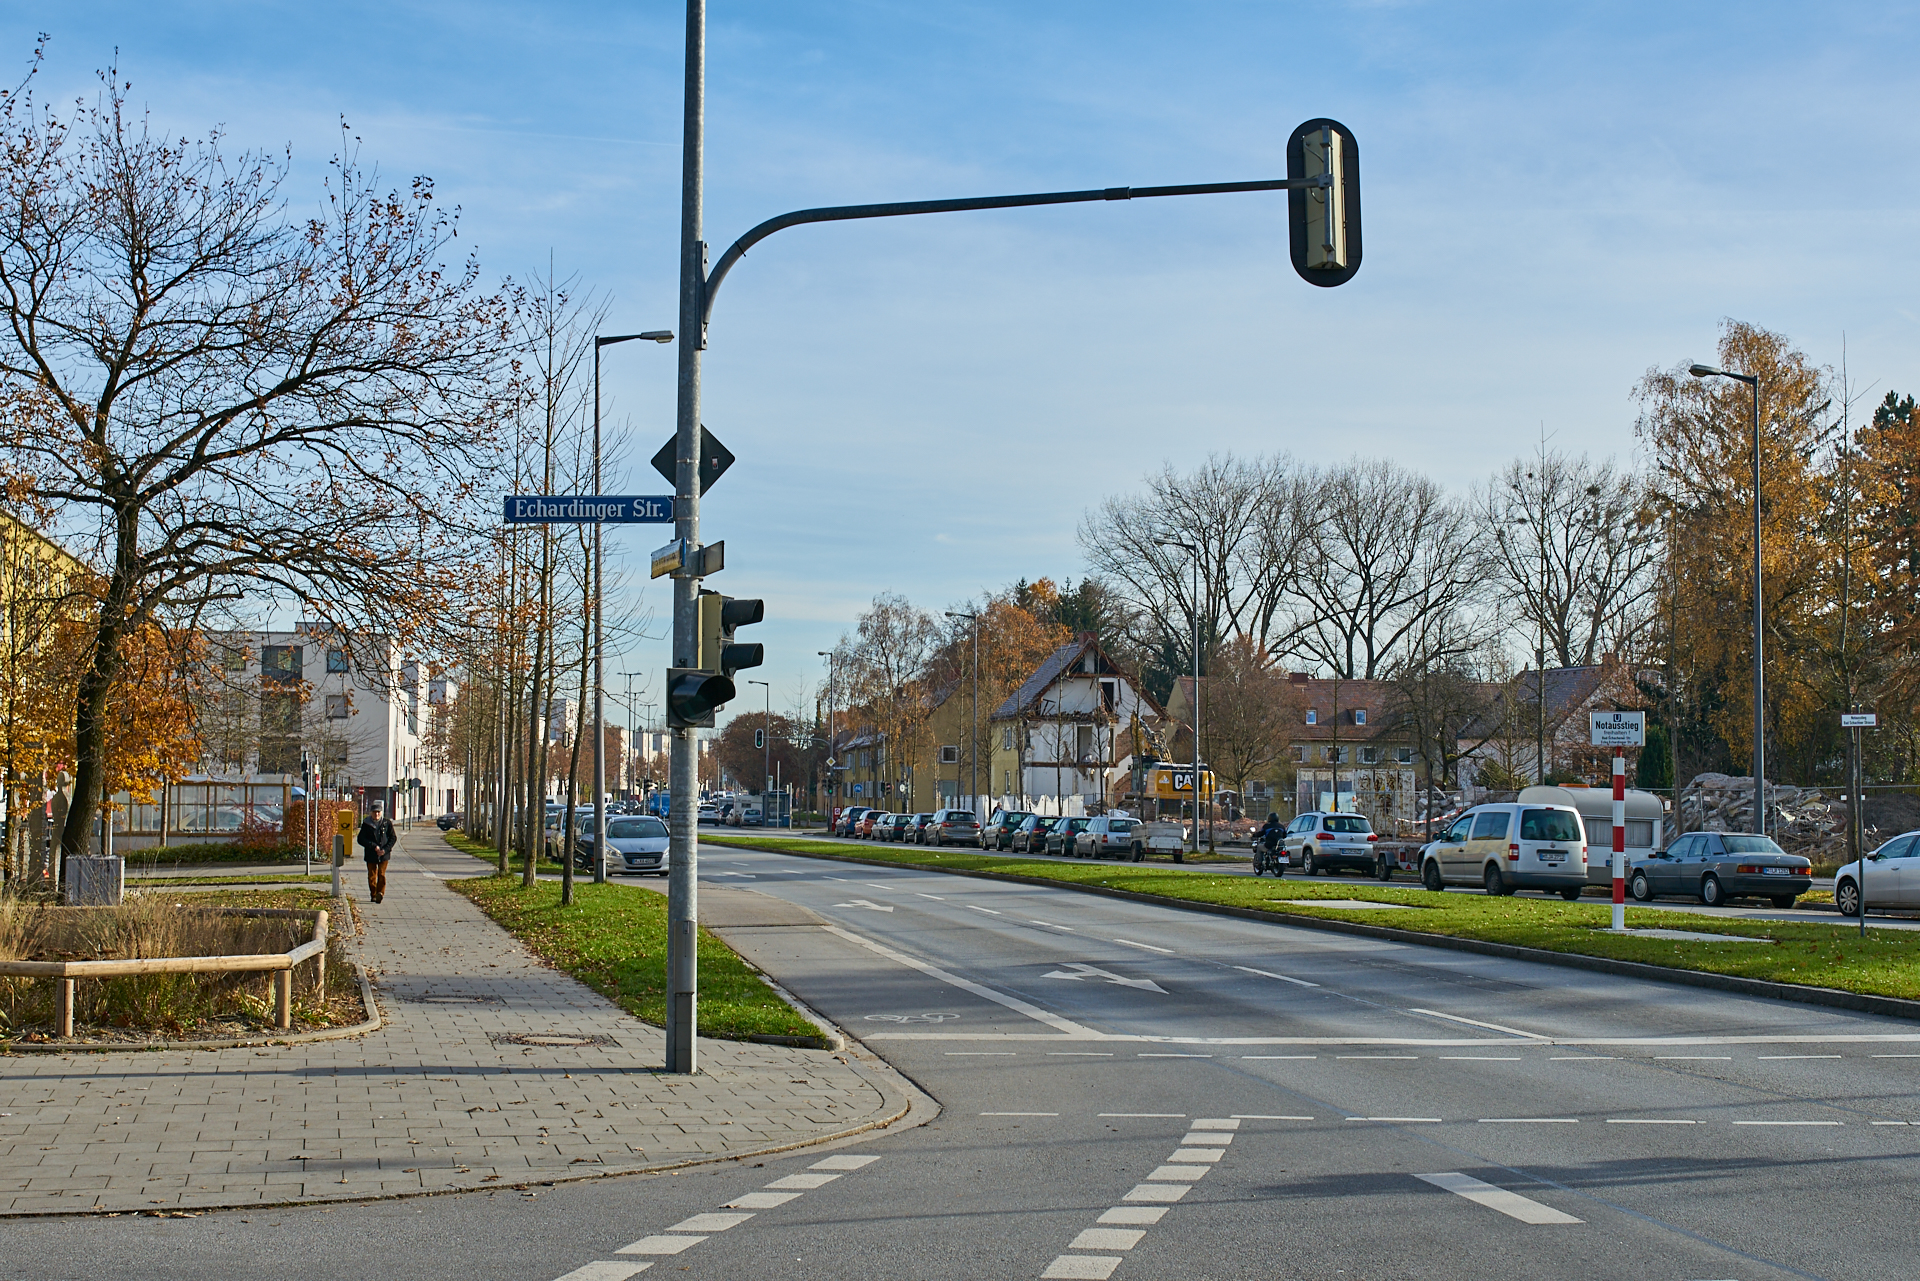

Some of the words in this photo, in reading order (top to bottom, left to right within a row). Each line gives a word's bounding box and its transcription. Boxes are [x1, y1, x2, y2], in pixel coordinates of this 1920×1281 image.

[514, 499, 626, 521] Echardinger
[632, 499, 664, 518] Str.
[1595, 721, 1639, 732] Notausstieg
